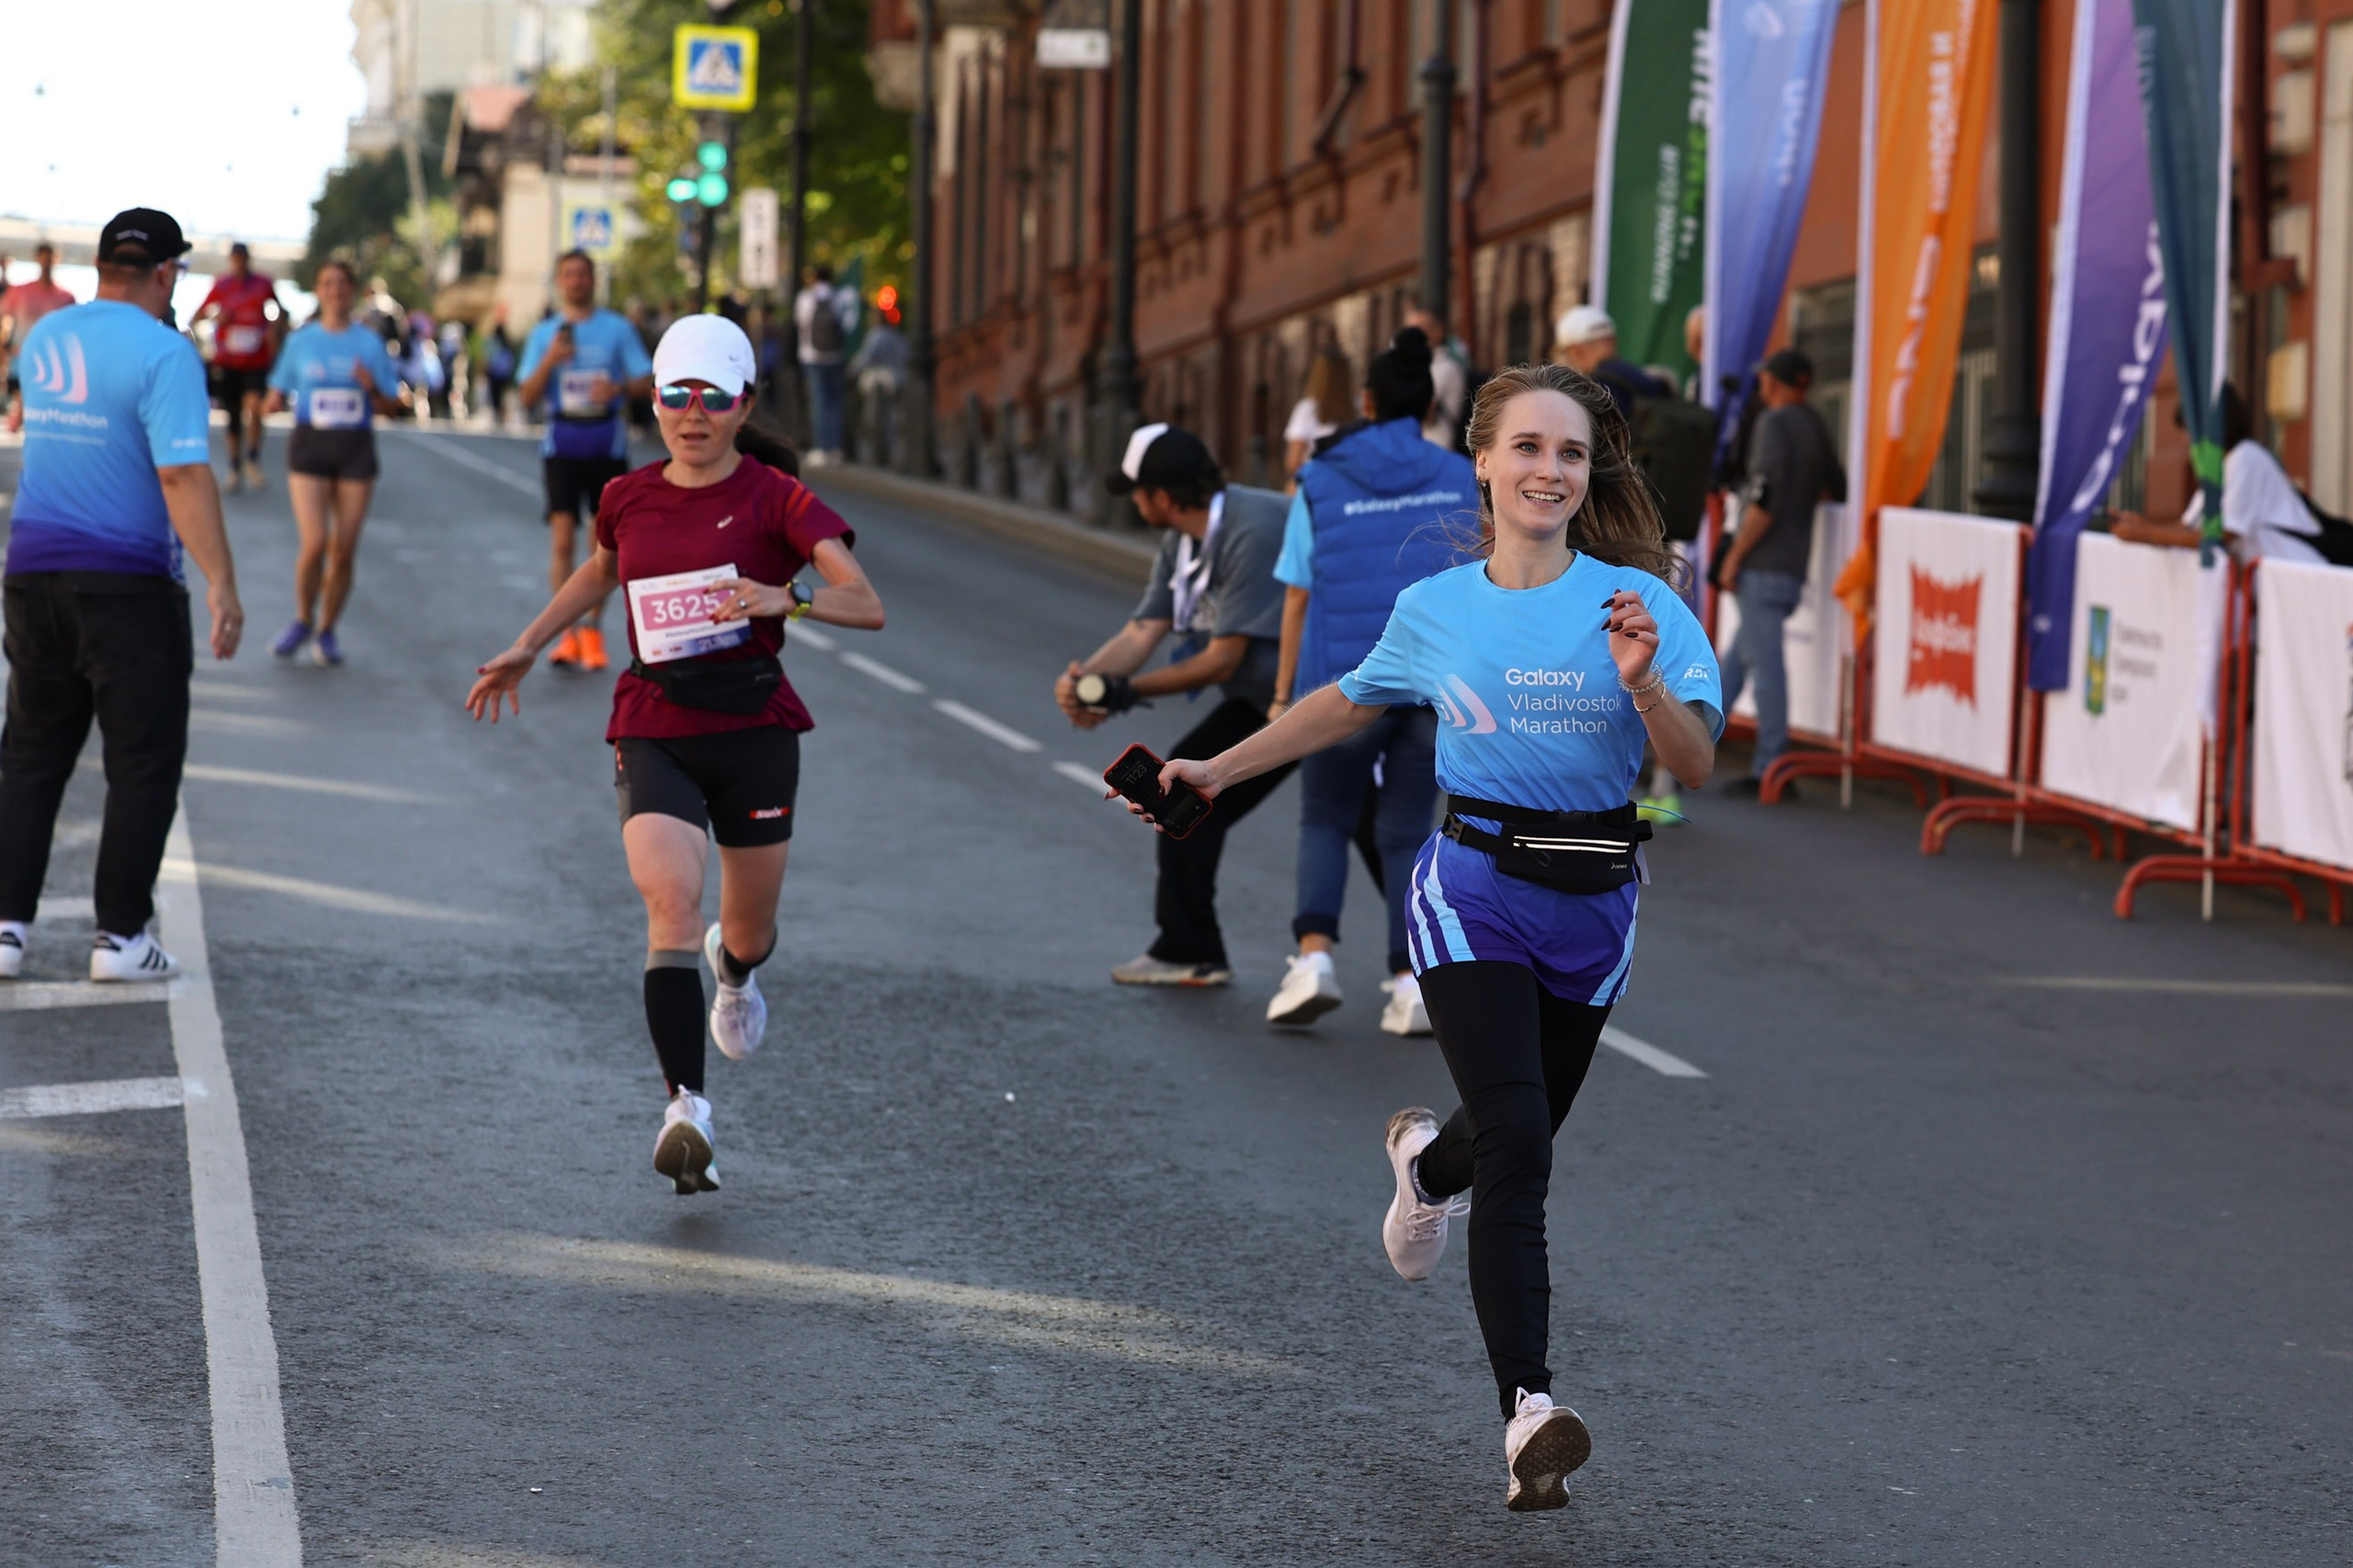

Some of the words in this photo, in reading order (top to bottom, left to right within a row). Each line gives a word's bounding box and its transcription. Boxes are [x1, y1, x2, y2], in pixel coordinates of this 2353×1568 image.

[651, 594, 721, 624] 3625
[1505, 668, 1586, 692] Galaxy
[1507, 693, 1622, 712] Vladivostok
[1510, 716, 1608, 734] Marathon
[1126, 764, 1148, 785] 11:23
